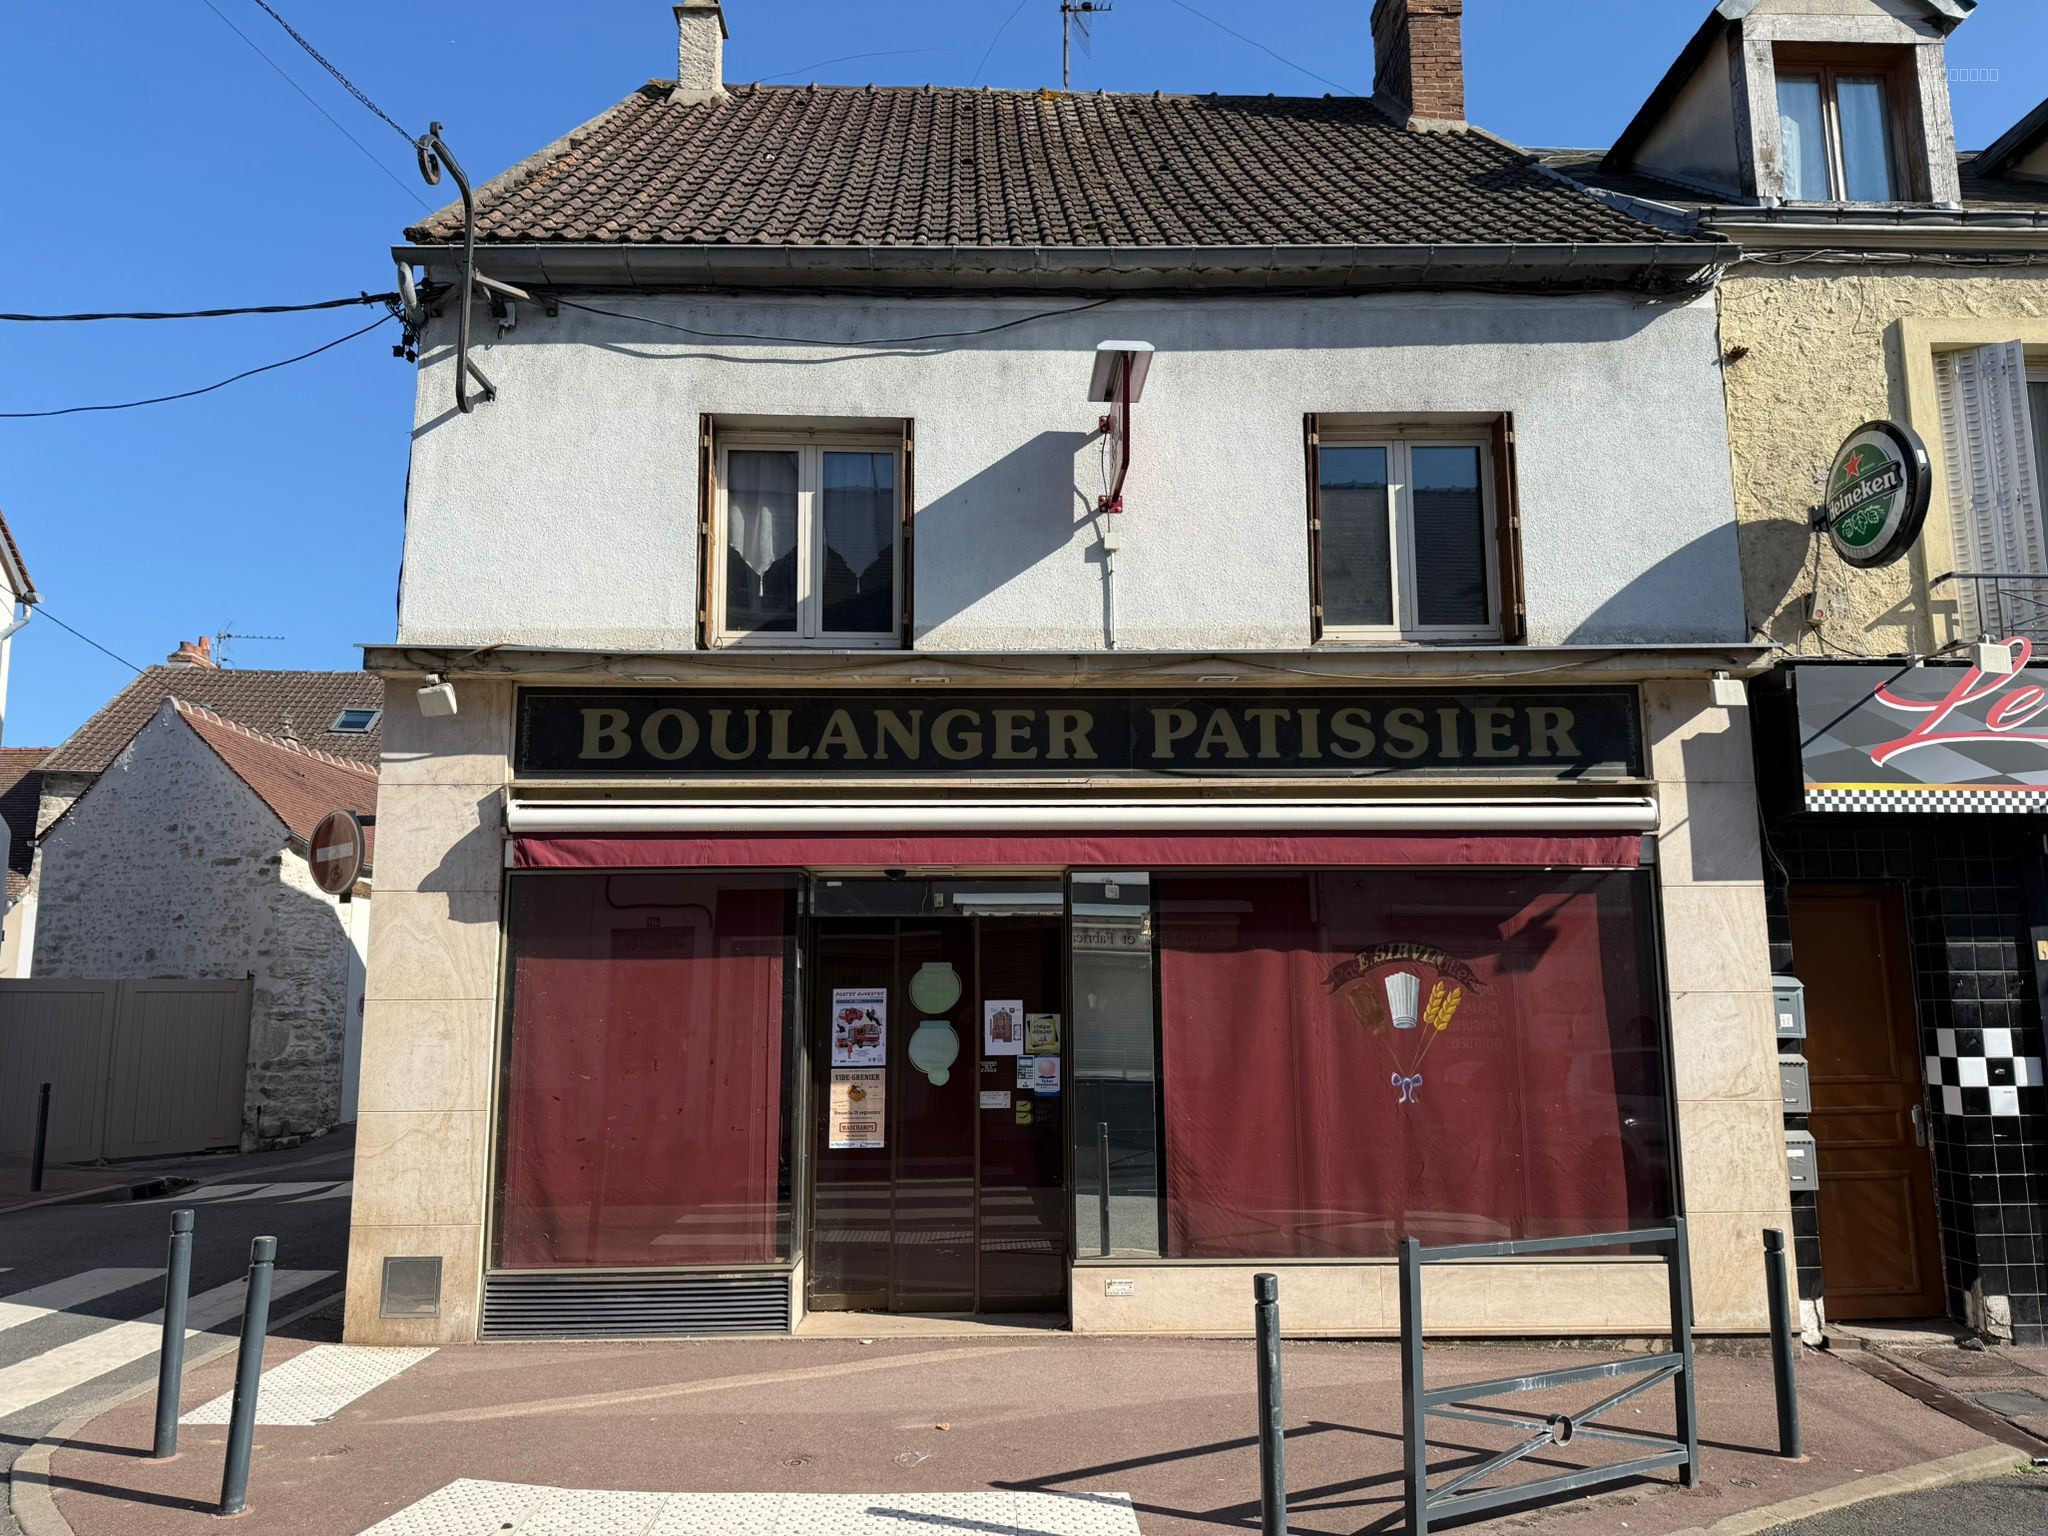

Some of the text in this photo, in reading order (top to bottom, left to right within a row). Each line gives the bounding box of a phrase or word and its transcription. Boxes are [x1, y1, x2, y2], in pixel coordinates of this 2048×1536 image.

[1828, 469, 1898, 523] Heineken
[1871, 636, 2048, 767] Le
[578, 706, 1582, 761] BOULANGER PATISSIER
